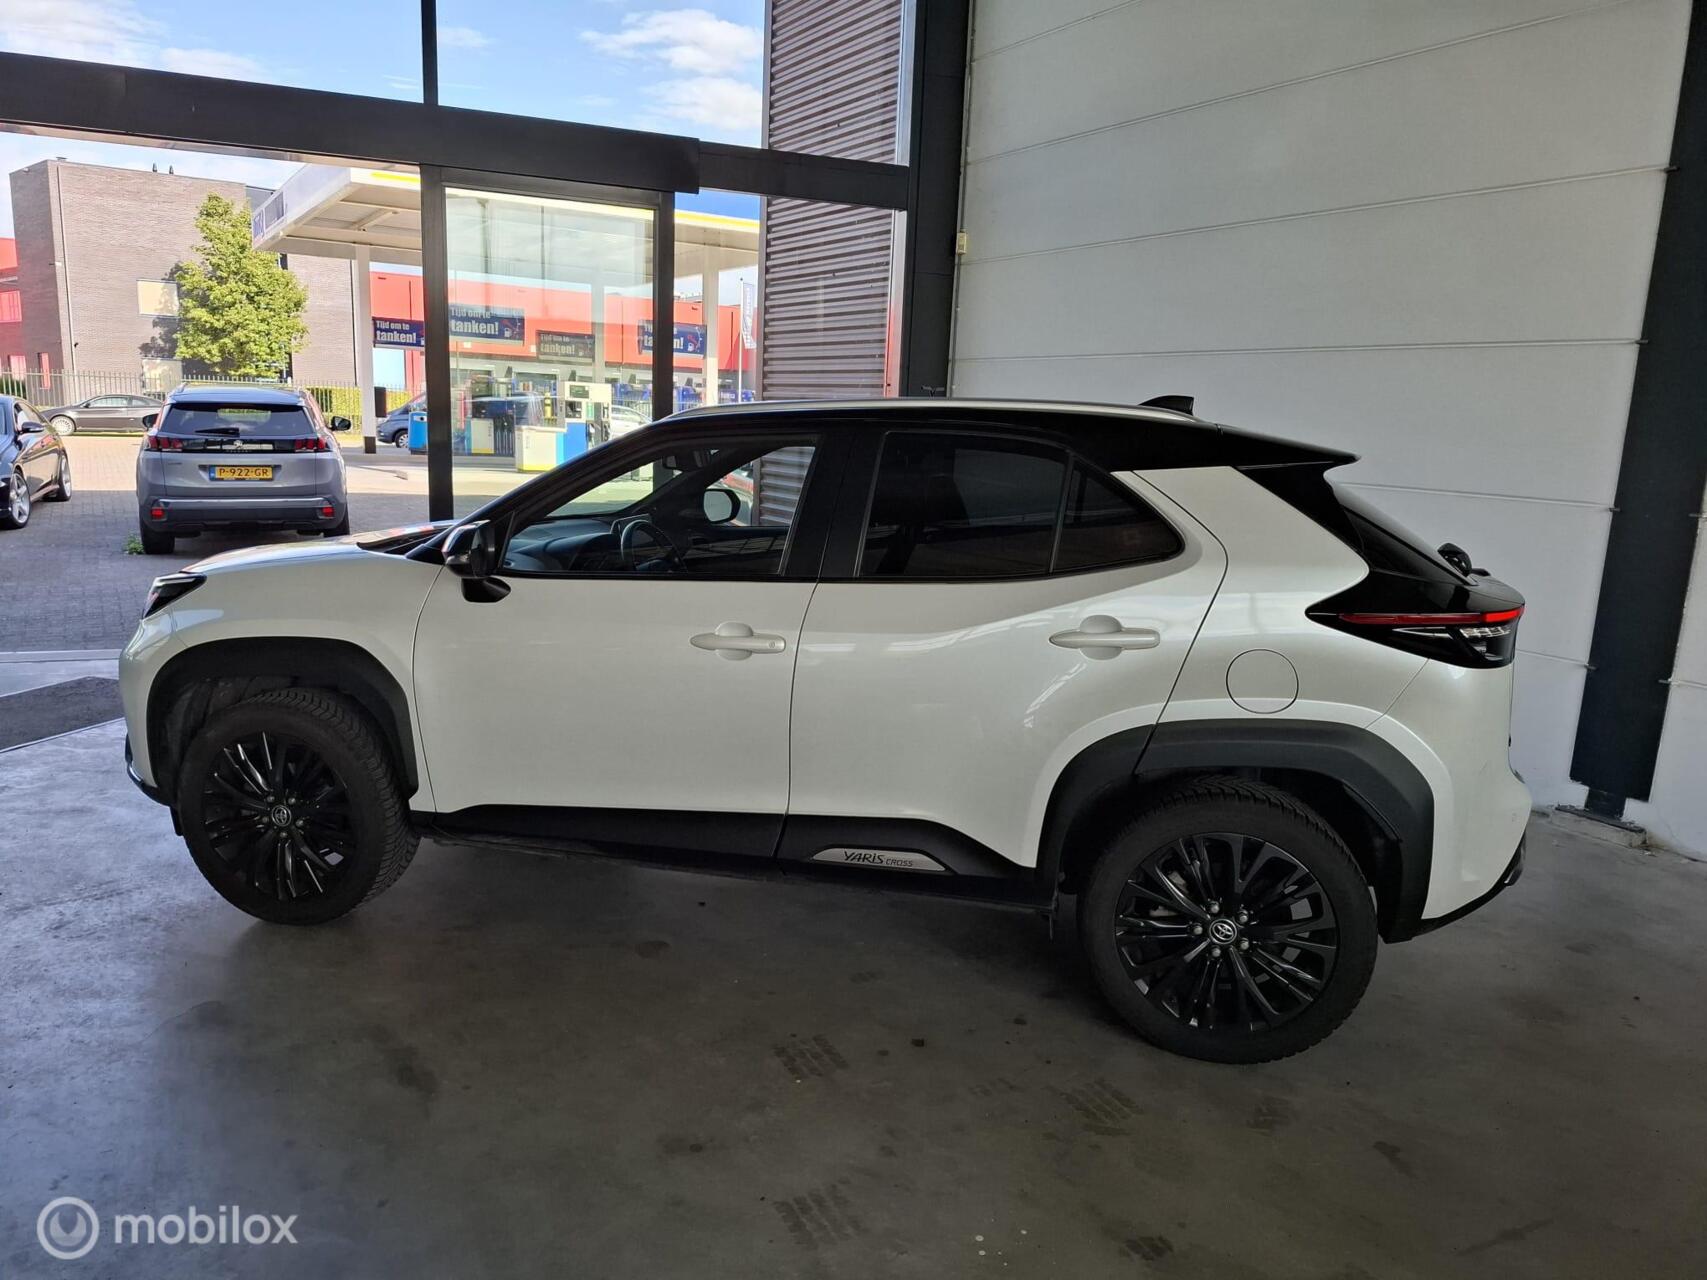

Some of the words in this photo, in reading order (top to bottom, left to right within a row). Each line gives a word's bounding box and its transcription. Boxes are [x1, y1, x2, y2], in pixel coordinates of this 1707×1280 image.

[376, 320, 390, 329] Tijd
[390, 322, 401, 330] om
[402, 322, 410, 330] te
[451, 320, 499, 335] tanken!
[376, 330, 417, 343] tanken!
[540, 343, 576, 355] tanken!
[219, 468, 269, 477] P-922-GR
[886, 858, 913, 867] CROSS
